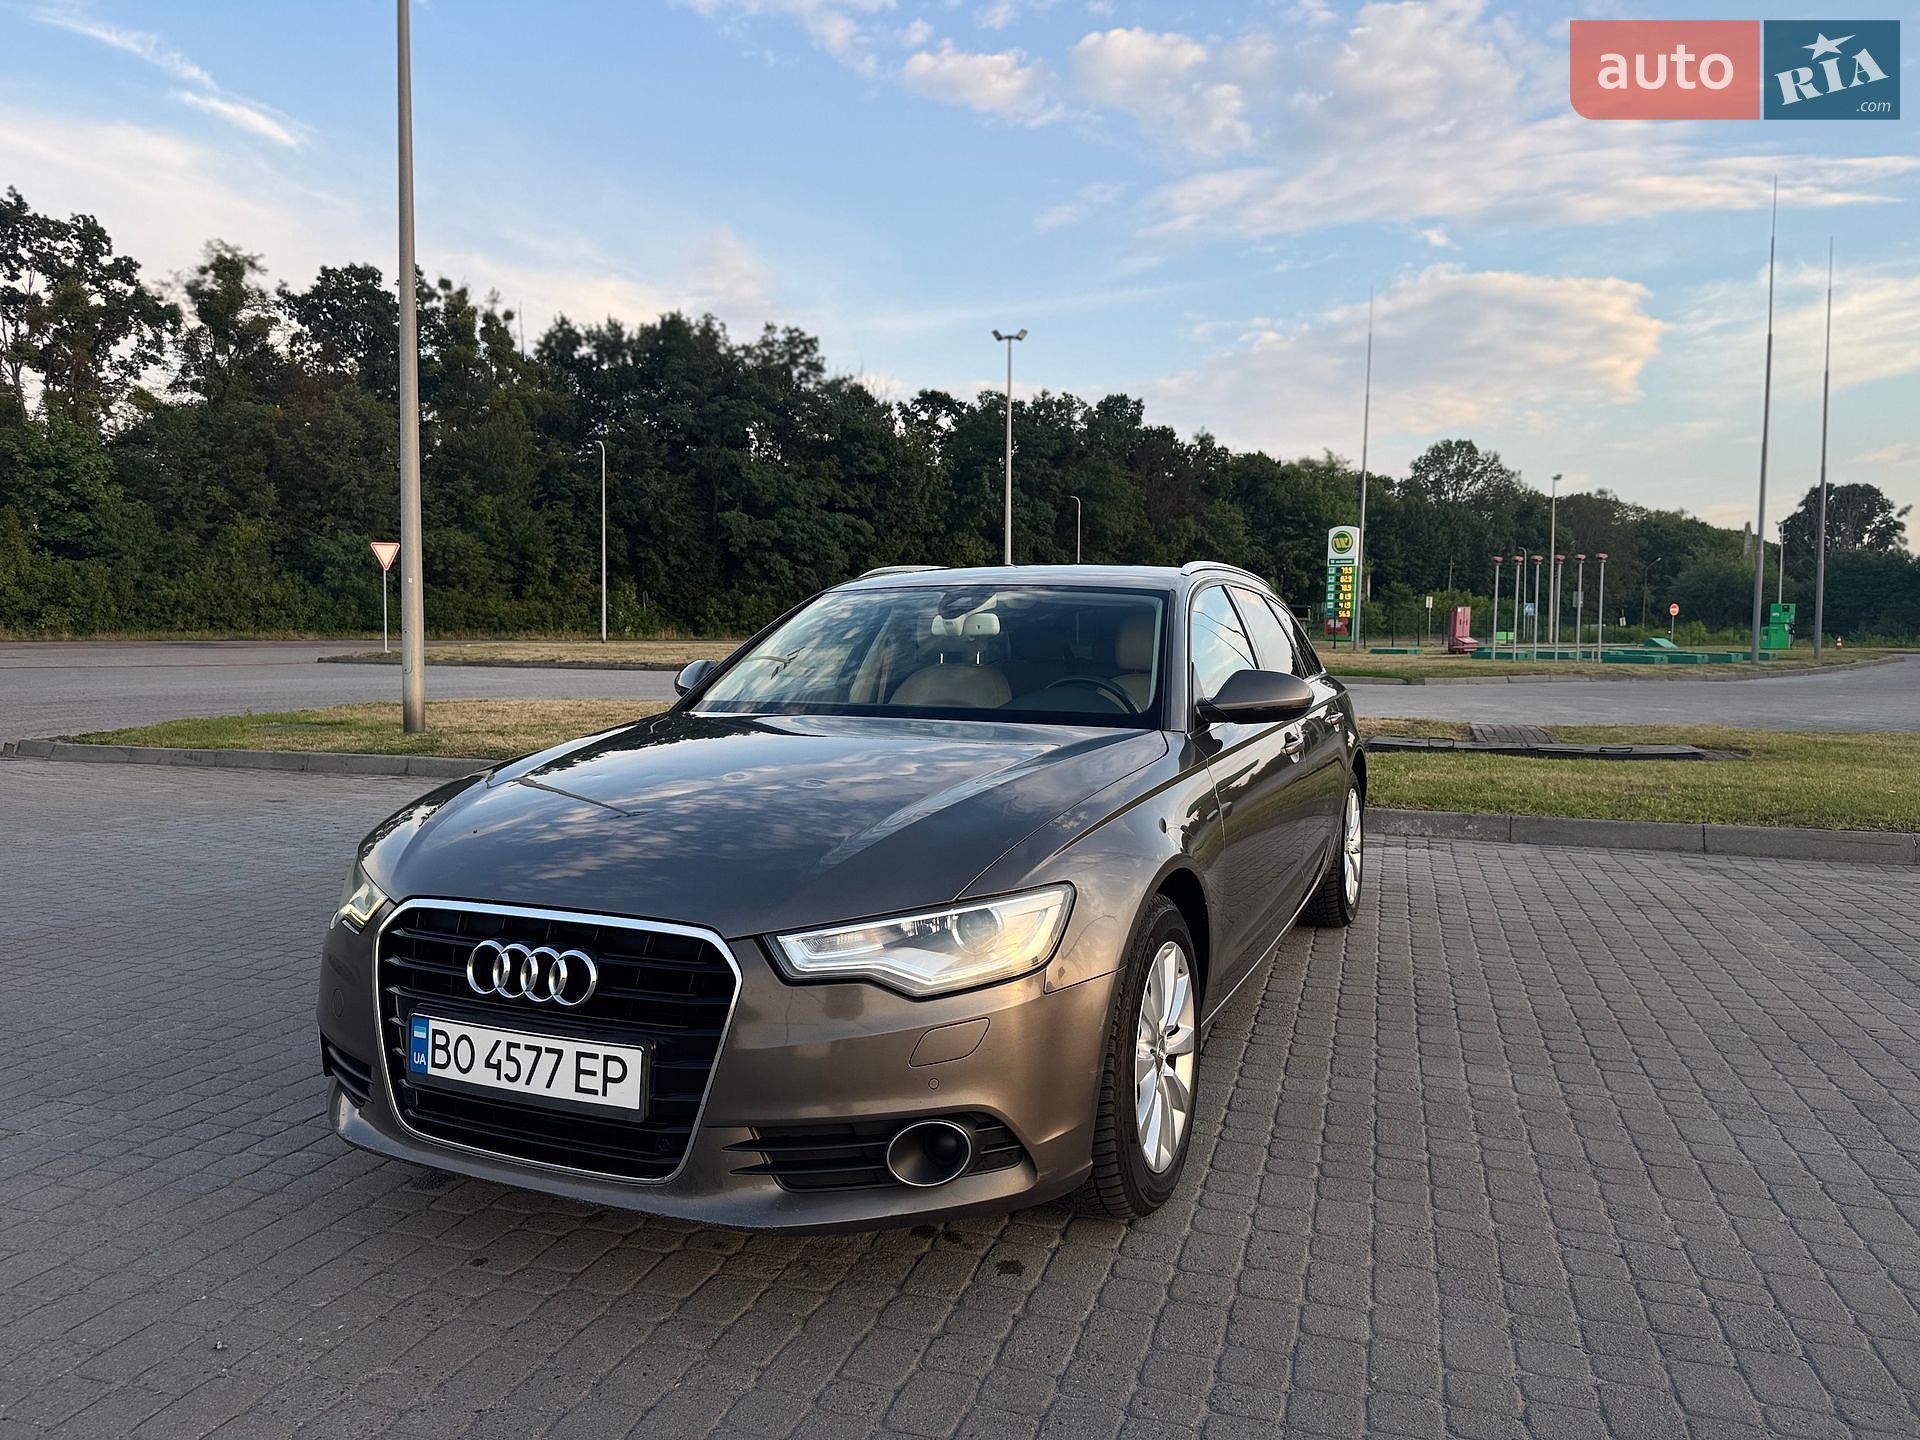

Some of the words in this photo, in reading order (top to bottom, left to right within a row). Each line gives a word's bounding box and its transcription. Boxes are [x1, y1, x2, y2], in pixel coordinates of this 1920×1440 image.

[413, 1051, 427, 1066] UA
[430, 1028, 476, 1075] BO
[484, 1039, 564, 1089] 4577
[574, 1050, 628, 1097] EP
